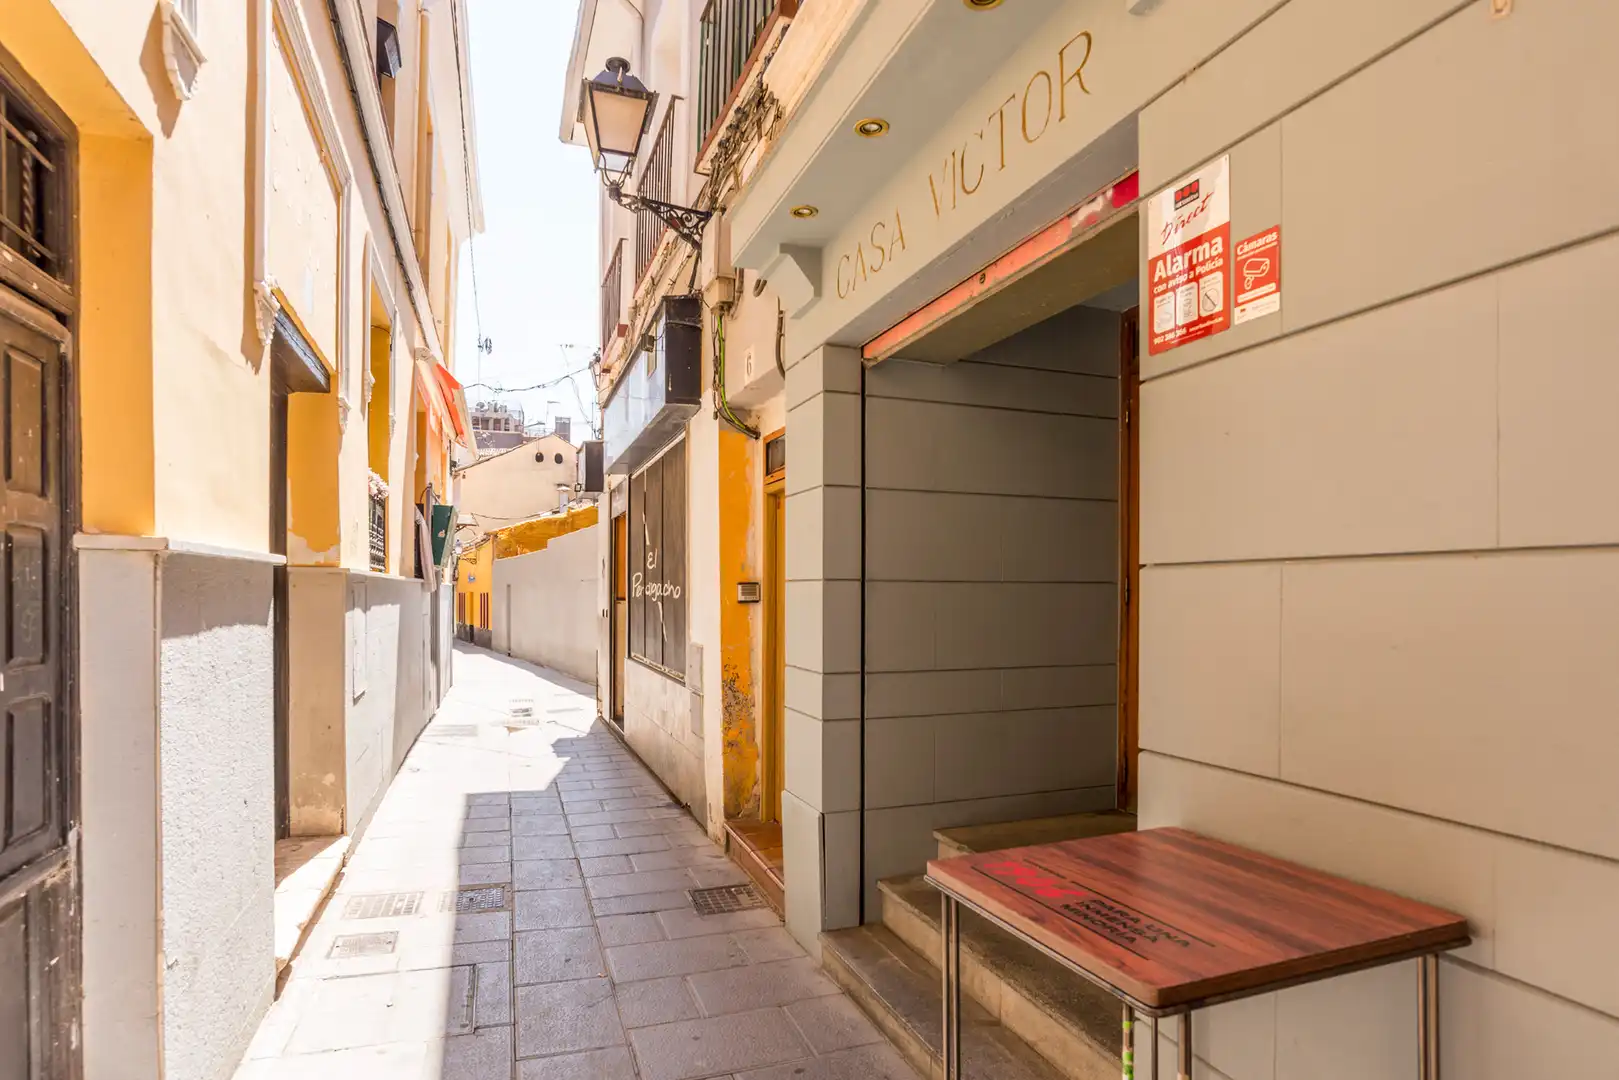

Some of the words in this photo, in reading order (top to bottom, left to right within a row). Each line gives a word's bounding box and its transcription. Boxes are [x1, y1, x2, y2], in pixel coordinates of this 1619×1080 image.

[837, 208, 905, 299] CASA
[929, 31, 1092, 219] VICTOR
[1161, 191, 1214, 245] Direct
[1154, 236, 1223, 282] Alarma
[1237, 231, 1278, 256] Cámaras
[1153, 283, 1167, 294] con
[1168, 273, 1188, 288] aviso
[1196, 256, 1223, 276] Policía
[647, 547, 658, 570] El
[1076, 901, 1157, 943] INMENSA
[1089, 899, 1140, 924] PARA
[1146, 923, 1190, 947] UNA
